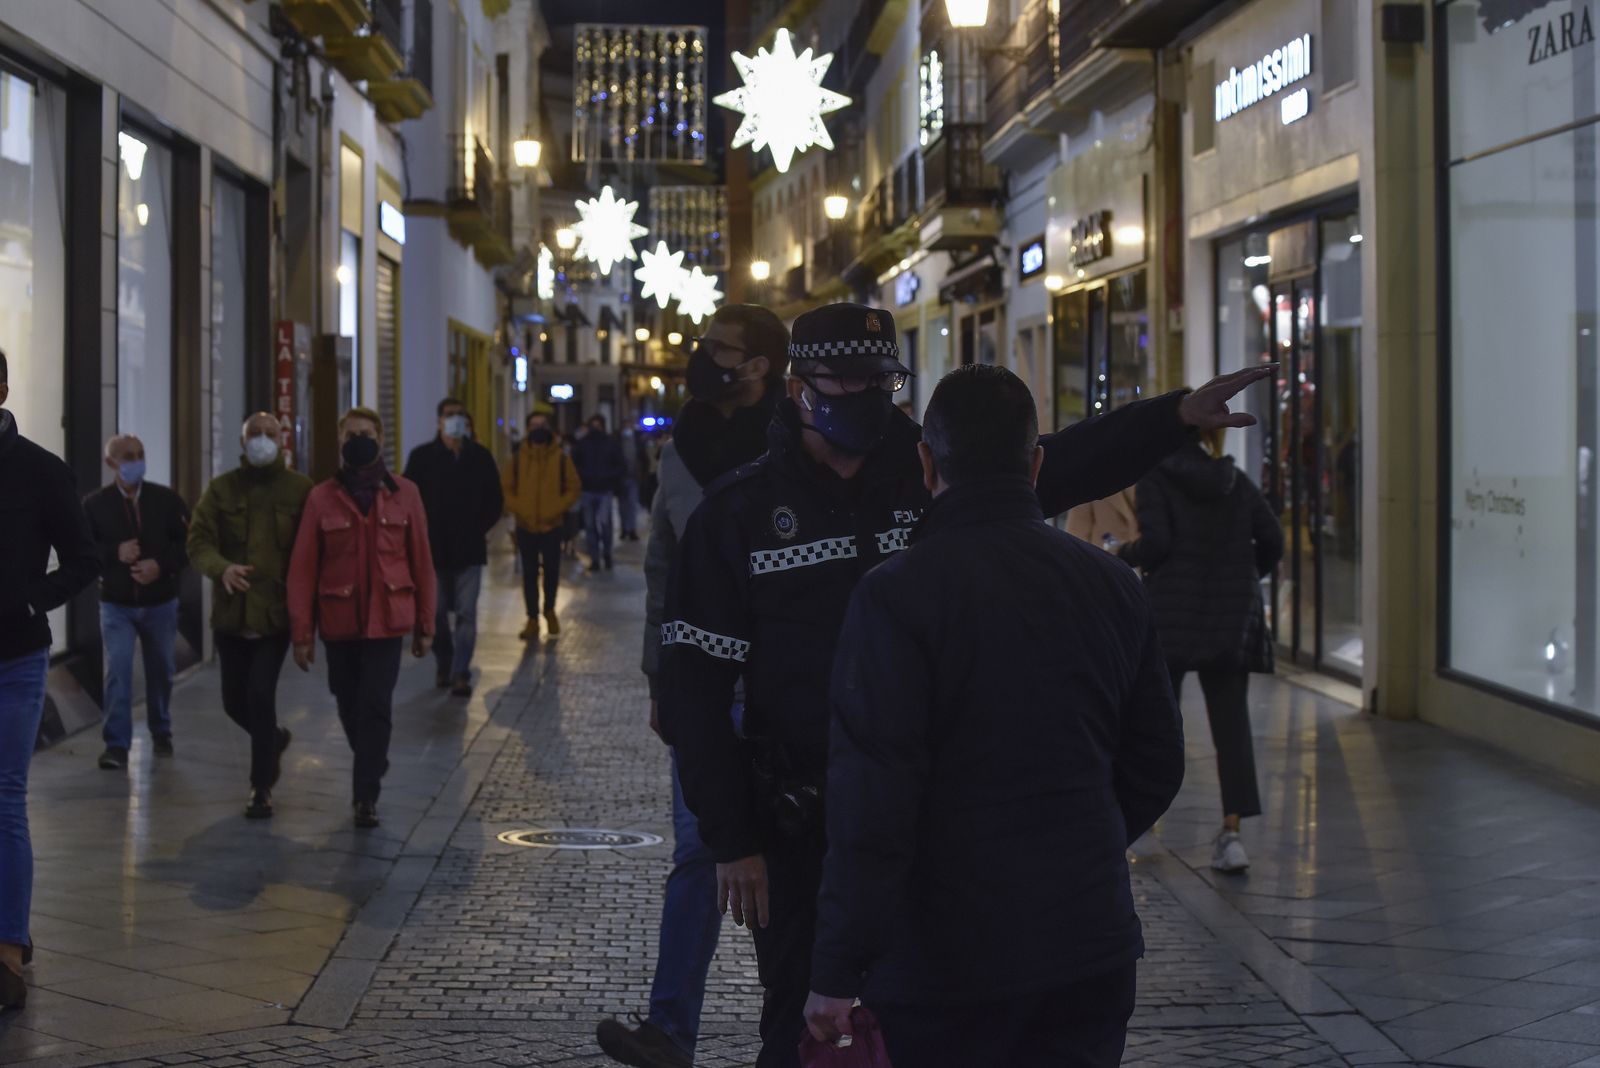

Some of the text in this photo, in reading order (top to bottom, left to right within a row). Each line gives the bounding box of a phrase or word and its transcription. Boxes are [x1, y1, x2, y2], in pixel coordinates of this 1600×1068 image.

[1528, 4, 1595, 65] ZARA
[1215, 33, 1310, 122] intimissimi
[278, 327, 292, 362] LA
